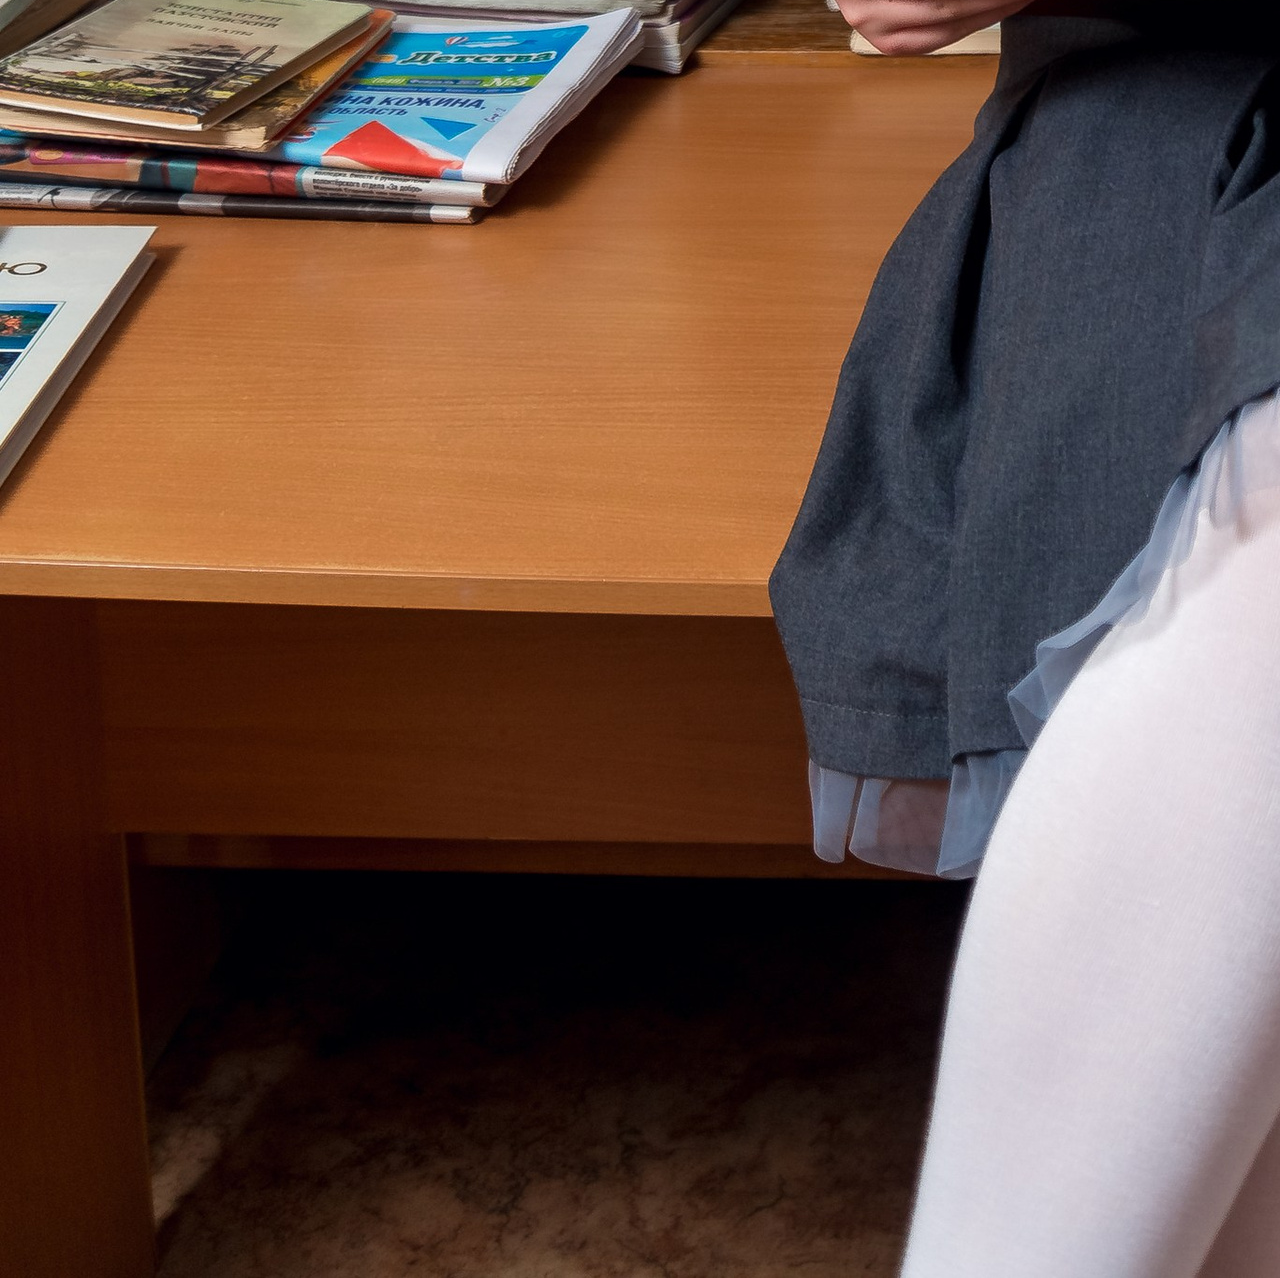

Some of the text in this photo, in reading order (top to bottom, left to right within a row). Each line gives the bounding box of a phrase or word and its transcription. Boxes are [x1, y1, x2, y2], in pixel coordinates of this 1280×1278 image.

[153, 7, 279, 28] ПАУСТОВСКИЙ
[167, 2, 283, 22] КОНСТАНТИН
[146, 18, 254, 36] ЗАЯЧЬИ ЛАПЫ
[399, 50, 556, 65] Детства
[378, 96, 487, 110] КОЖИНА,
[328, 107, 409, 116] ОБЛАСТЬ
[362, 182, 385, 190] отдела
